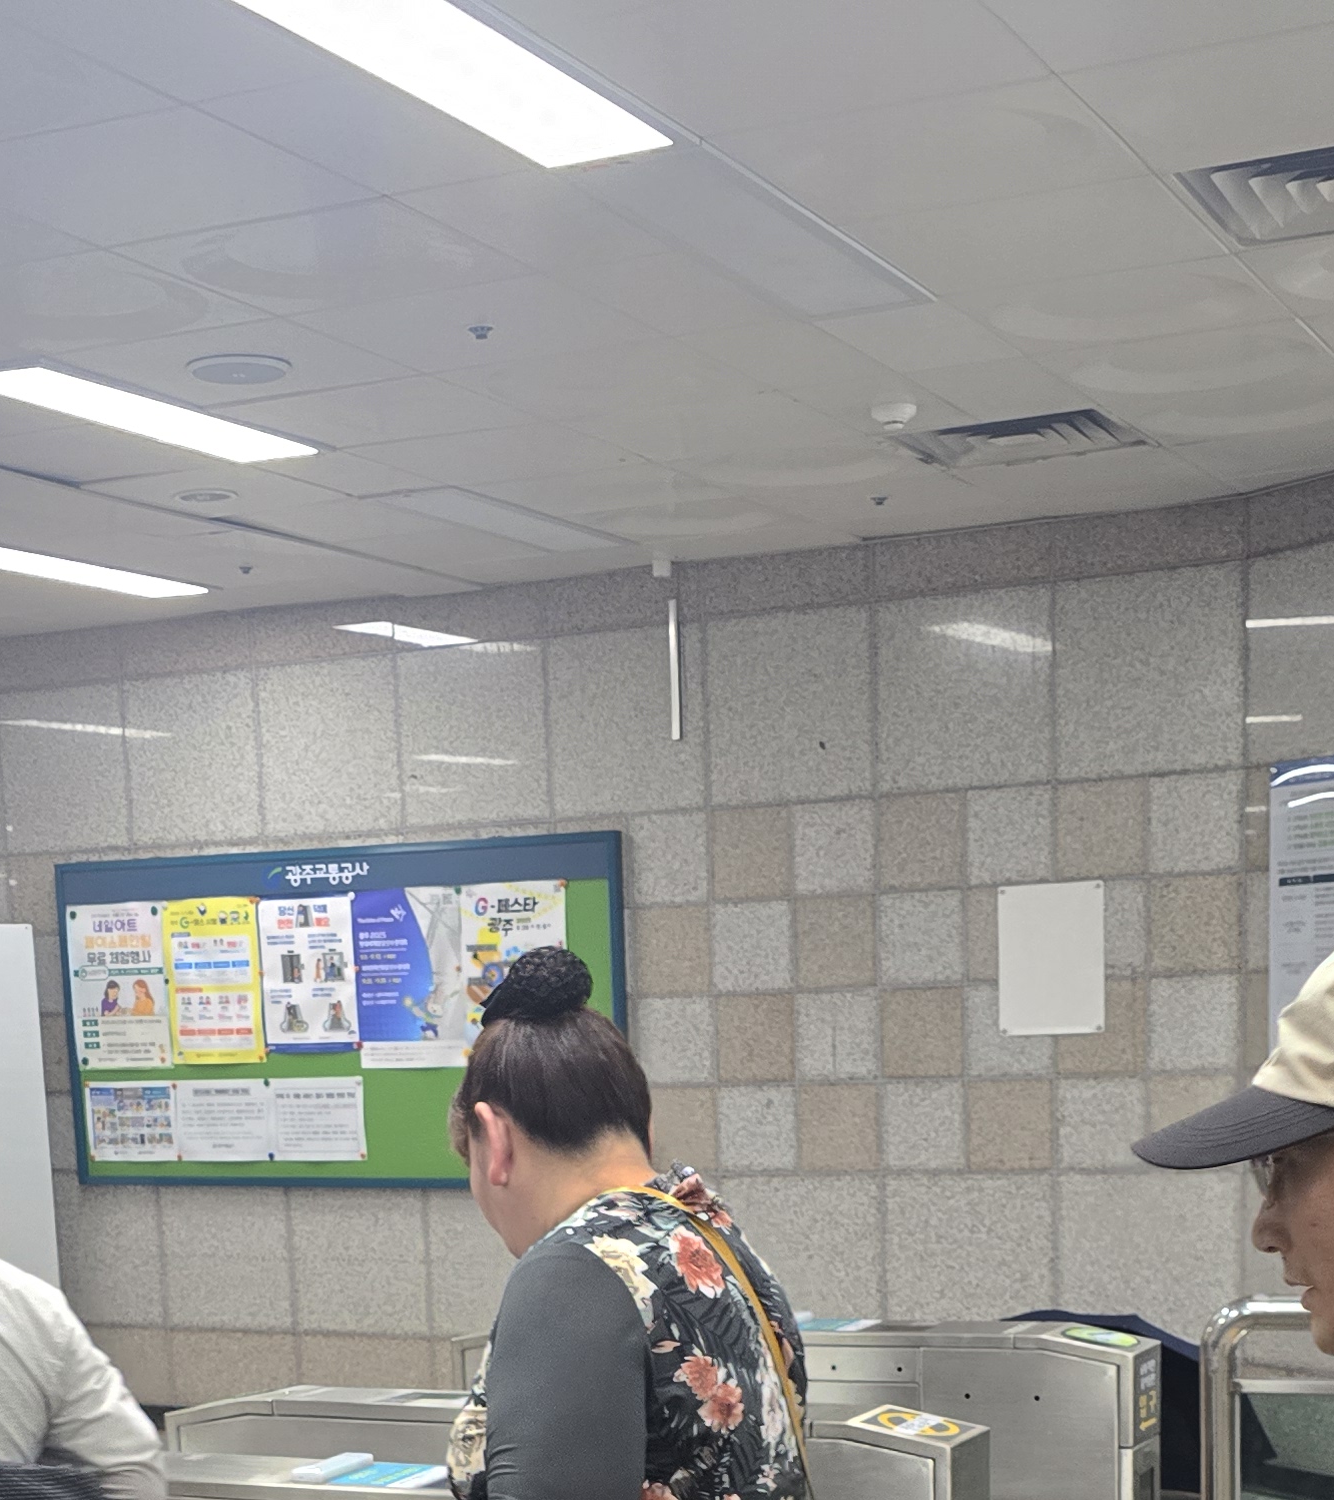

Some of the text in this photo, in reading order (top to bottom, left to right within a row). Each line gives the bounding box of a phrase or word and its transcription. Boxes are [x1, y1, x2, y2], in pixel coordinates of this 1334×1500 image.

[284, 862, 370, 887] 광주교통공사
[92, 918, 138, 933] 네일아트
[487, 917, 514, 937] 광주
[87, 952, 107, 966] 무료
